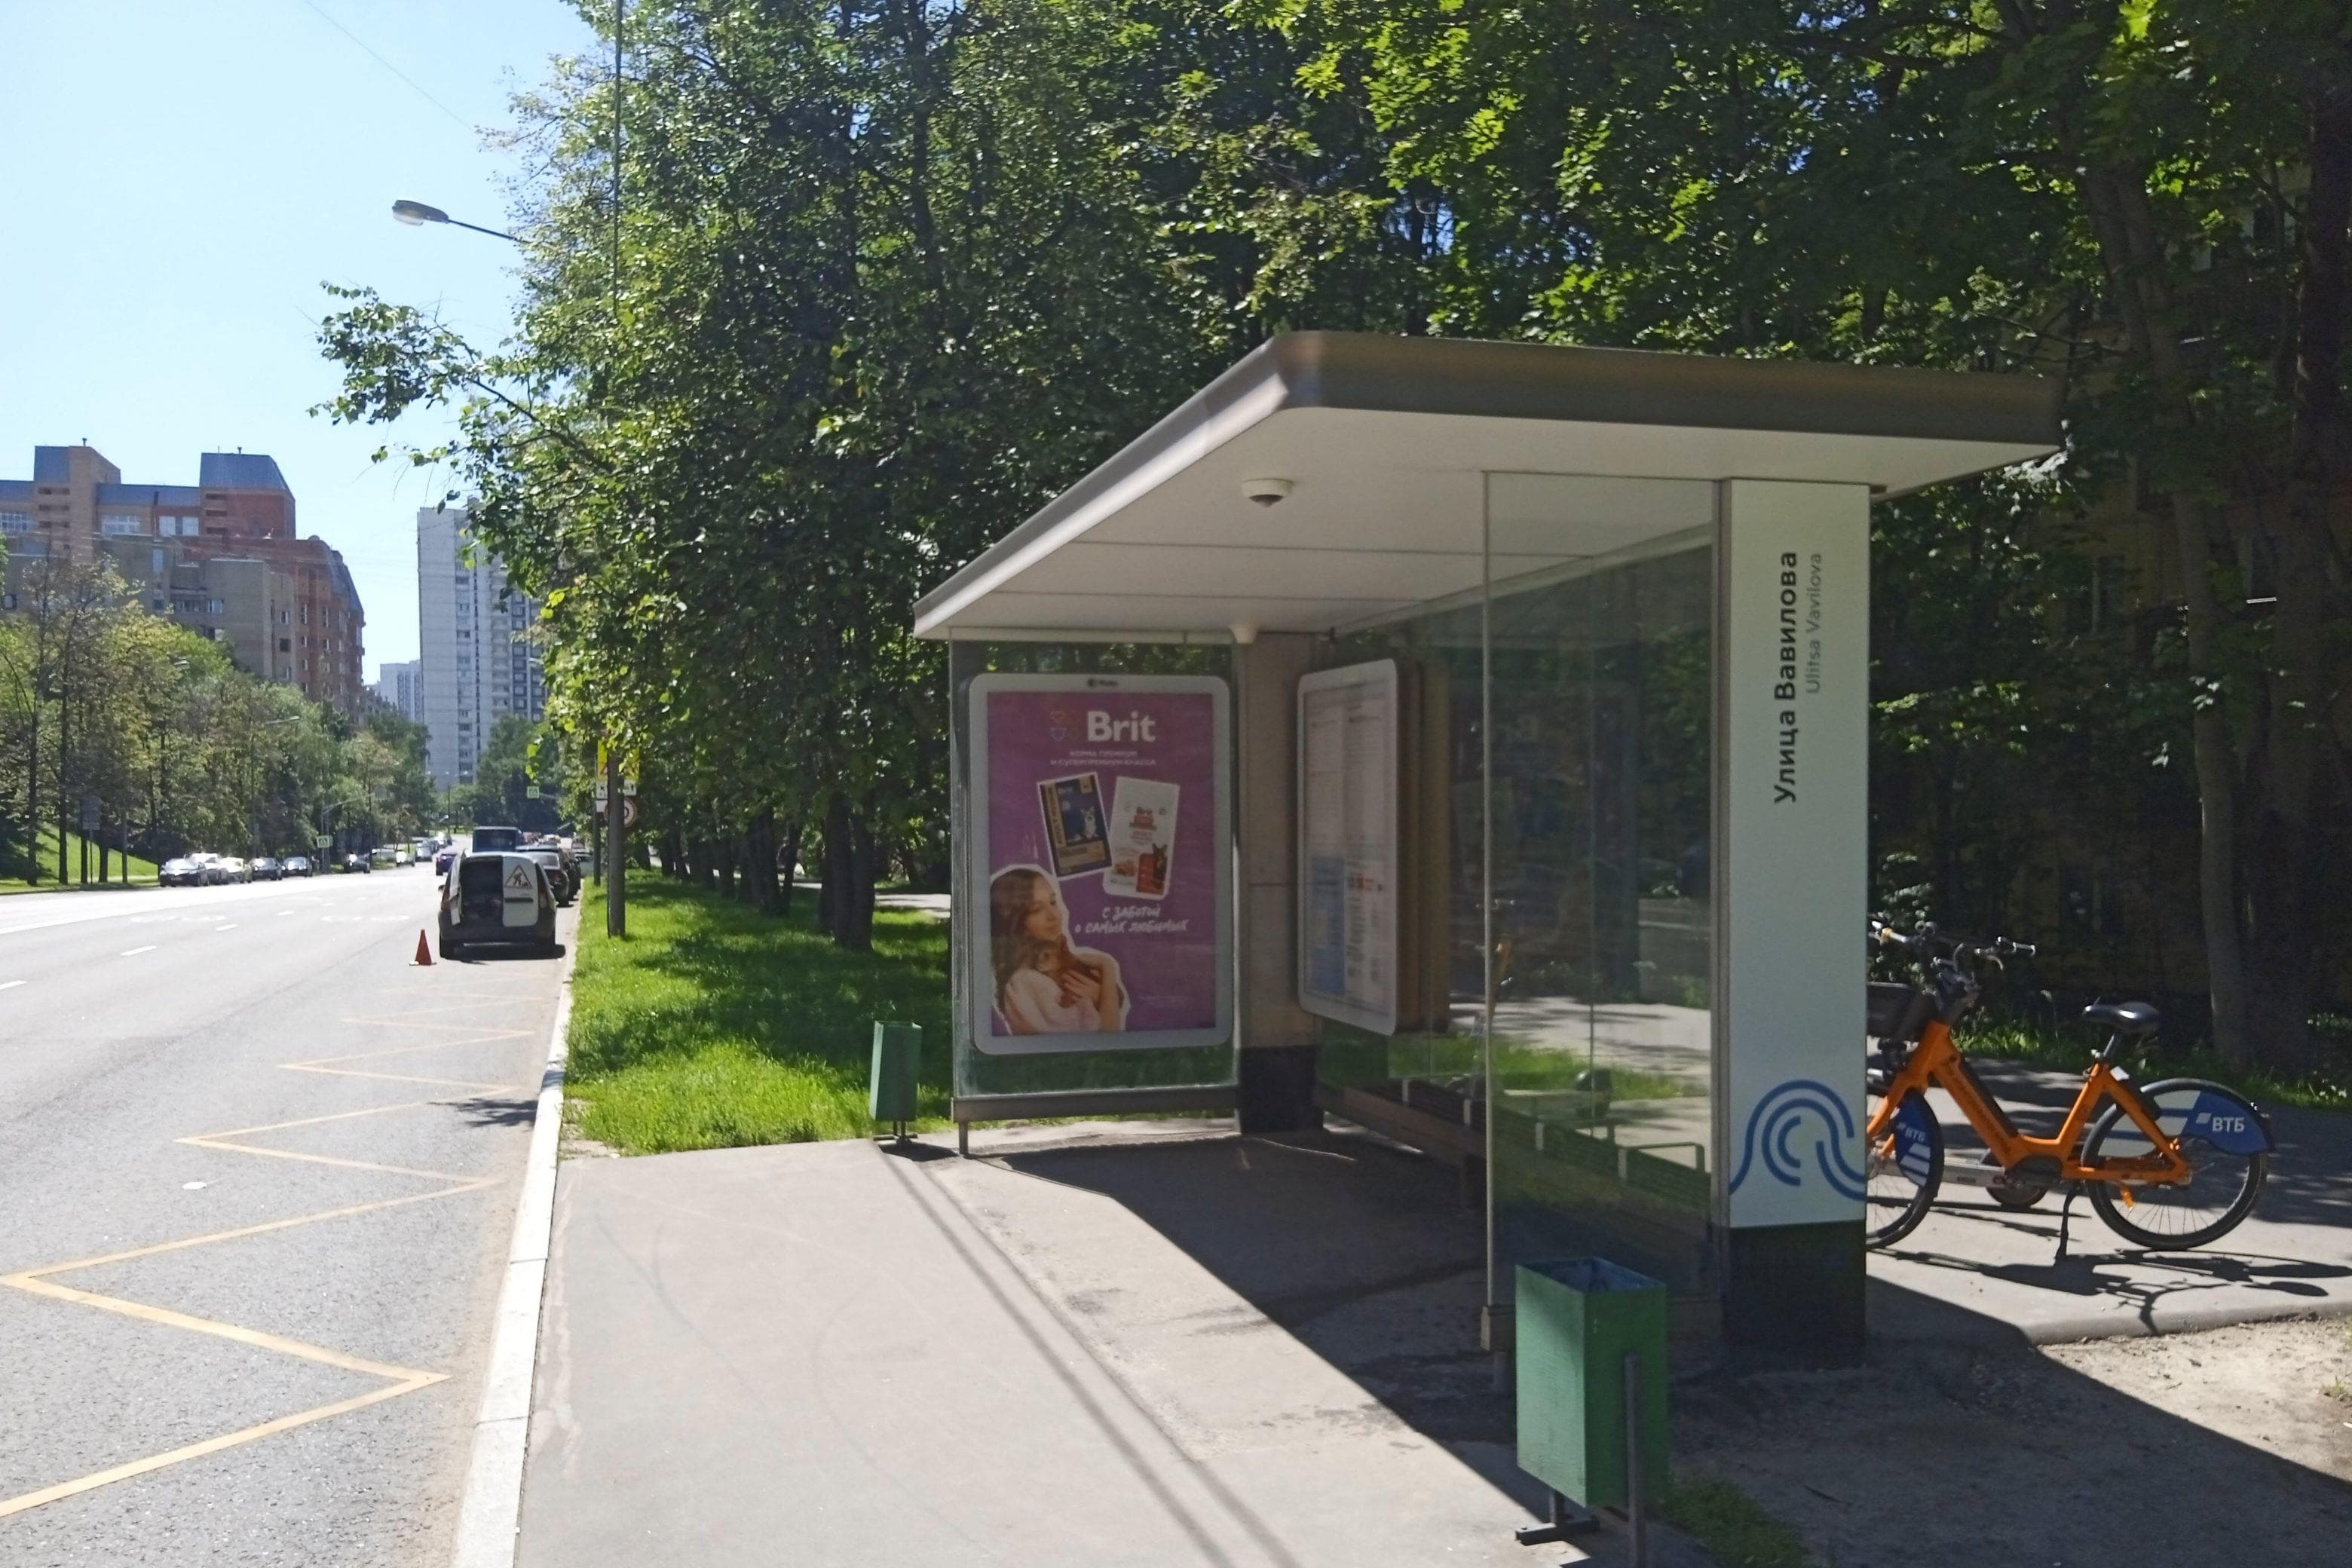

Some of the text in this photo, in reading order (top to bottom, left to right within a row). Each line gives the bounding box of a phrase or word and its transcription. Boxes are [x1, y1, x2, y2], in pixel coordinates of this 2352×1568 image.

[1805, 553, 1821, 694] Ulitsa Vavilova
[1774, 553, 1799, 804] Улица Вавилова
[1087, 711, 1156, 743] Brit
[2212, 1116, 2245, 1132] ВТБ
